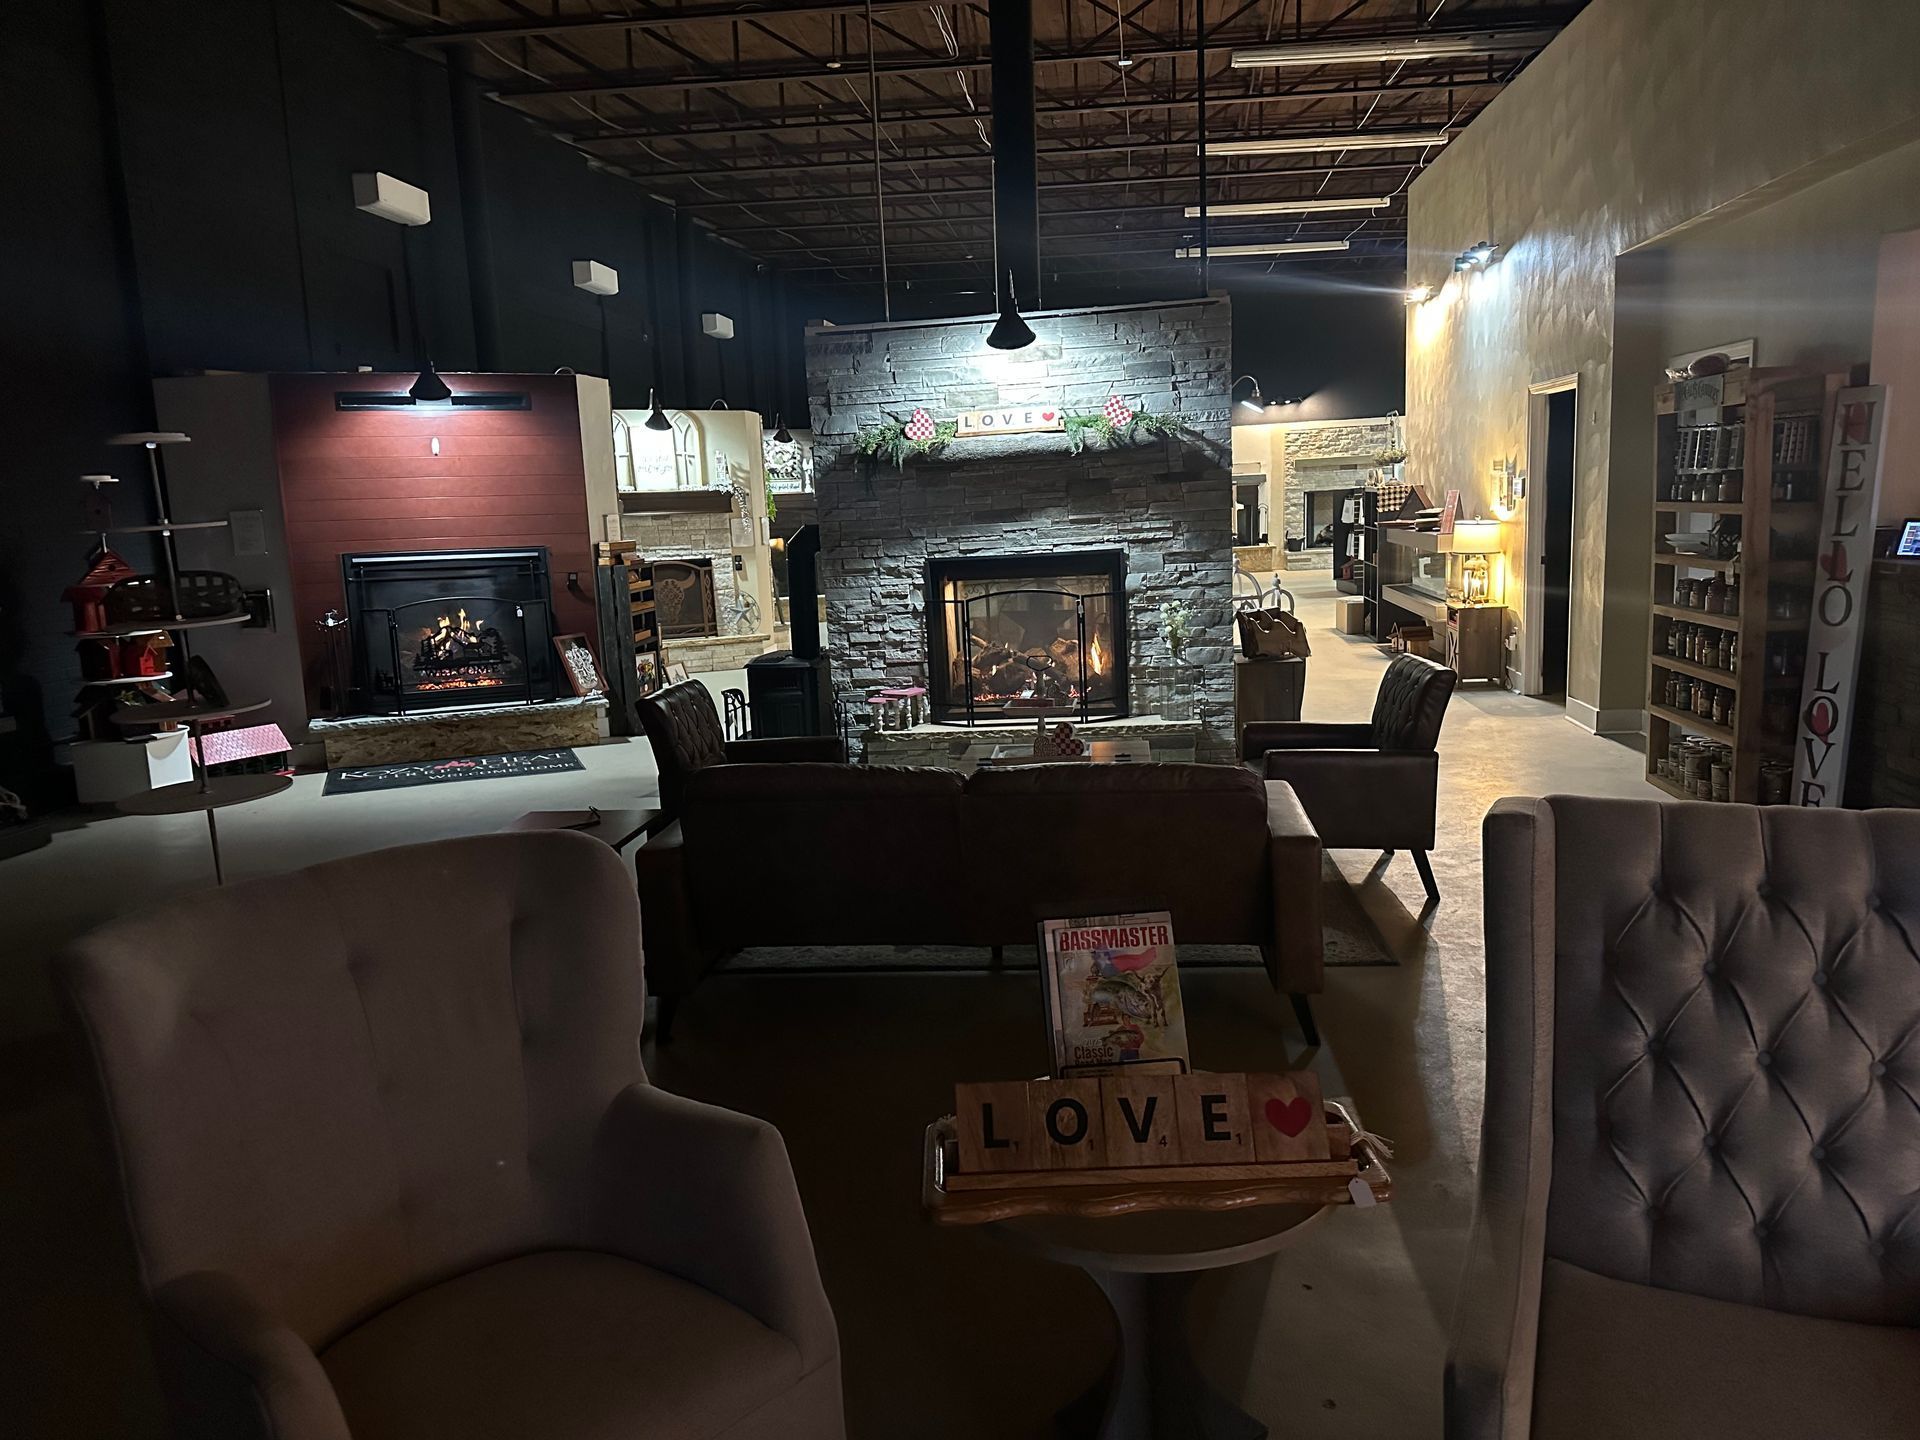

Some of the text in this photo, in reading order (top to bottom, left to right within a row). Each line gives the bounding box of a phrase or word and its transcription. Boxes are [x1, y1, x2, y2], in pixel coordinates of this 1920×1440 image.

[964, 411, 1033, 428] LOVE
[1818, 400, 1877, 628] HELLO
[1801, 651, 1841, 808] LOVE
[340, 752, 568, 780] KOZY HEAT
[429, 762, 576, 780] WELCOME HOME
[1059, 925, 1170, 952] BASSMASTER
[1073, 1046, 1114, 1060] Classic
[982, 1094, 1232, 1149] LOVE
